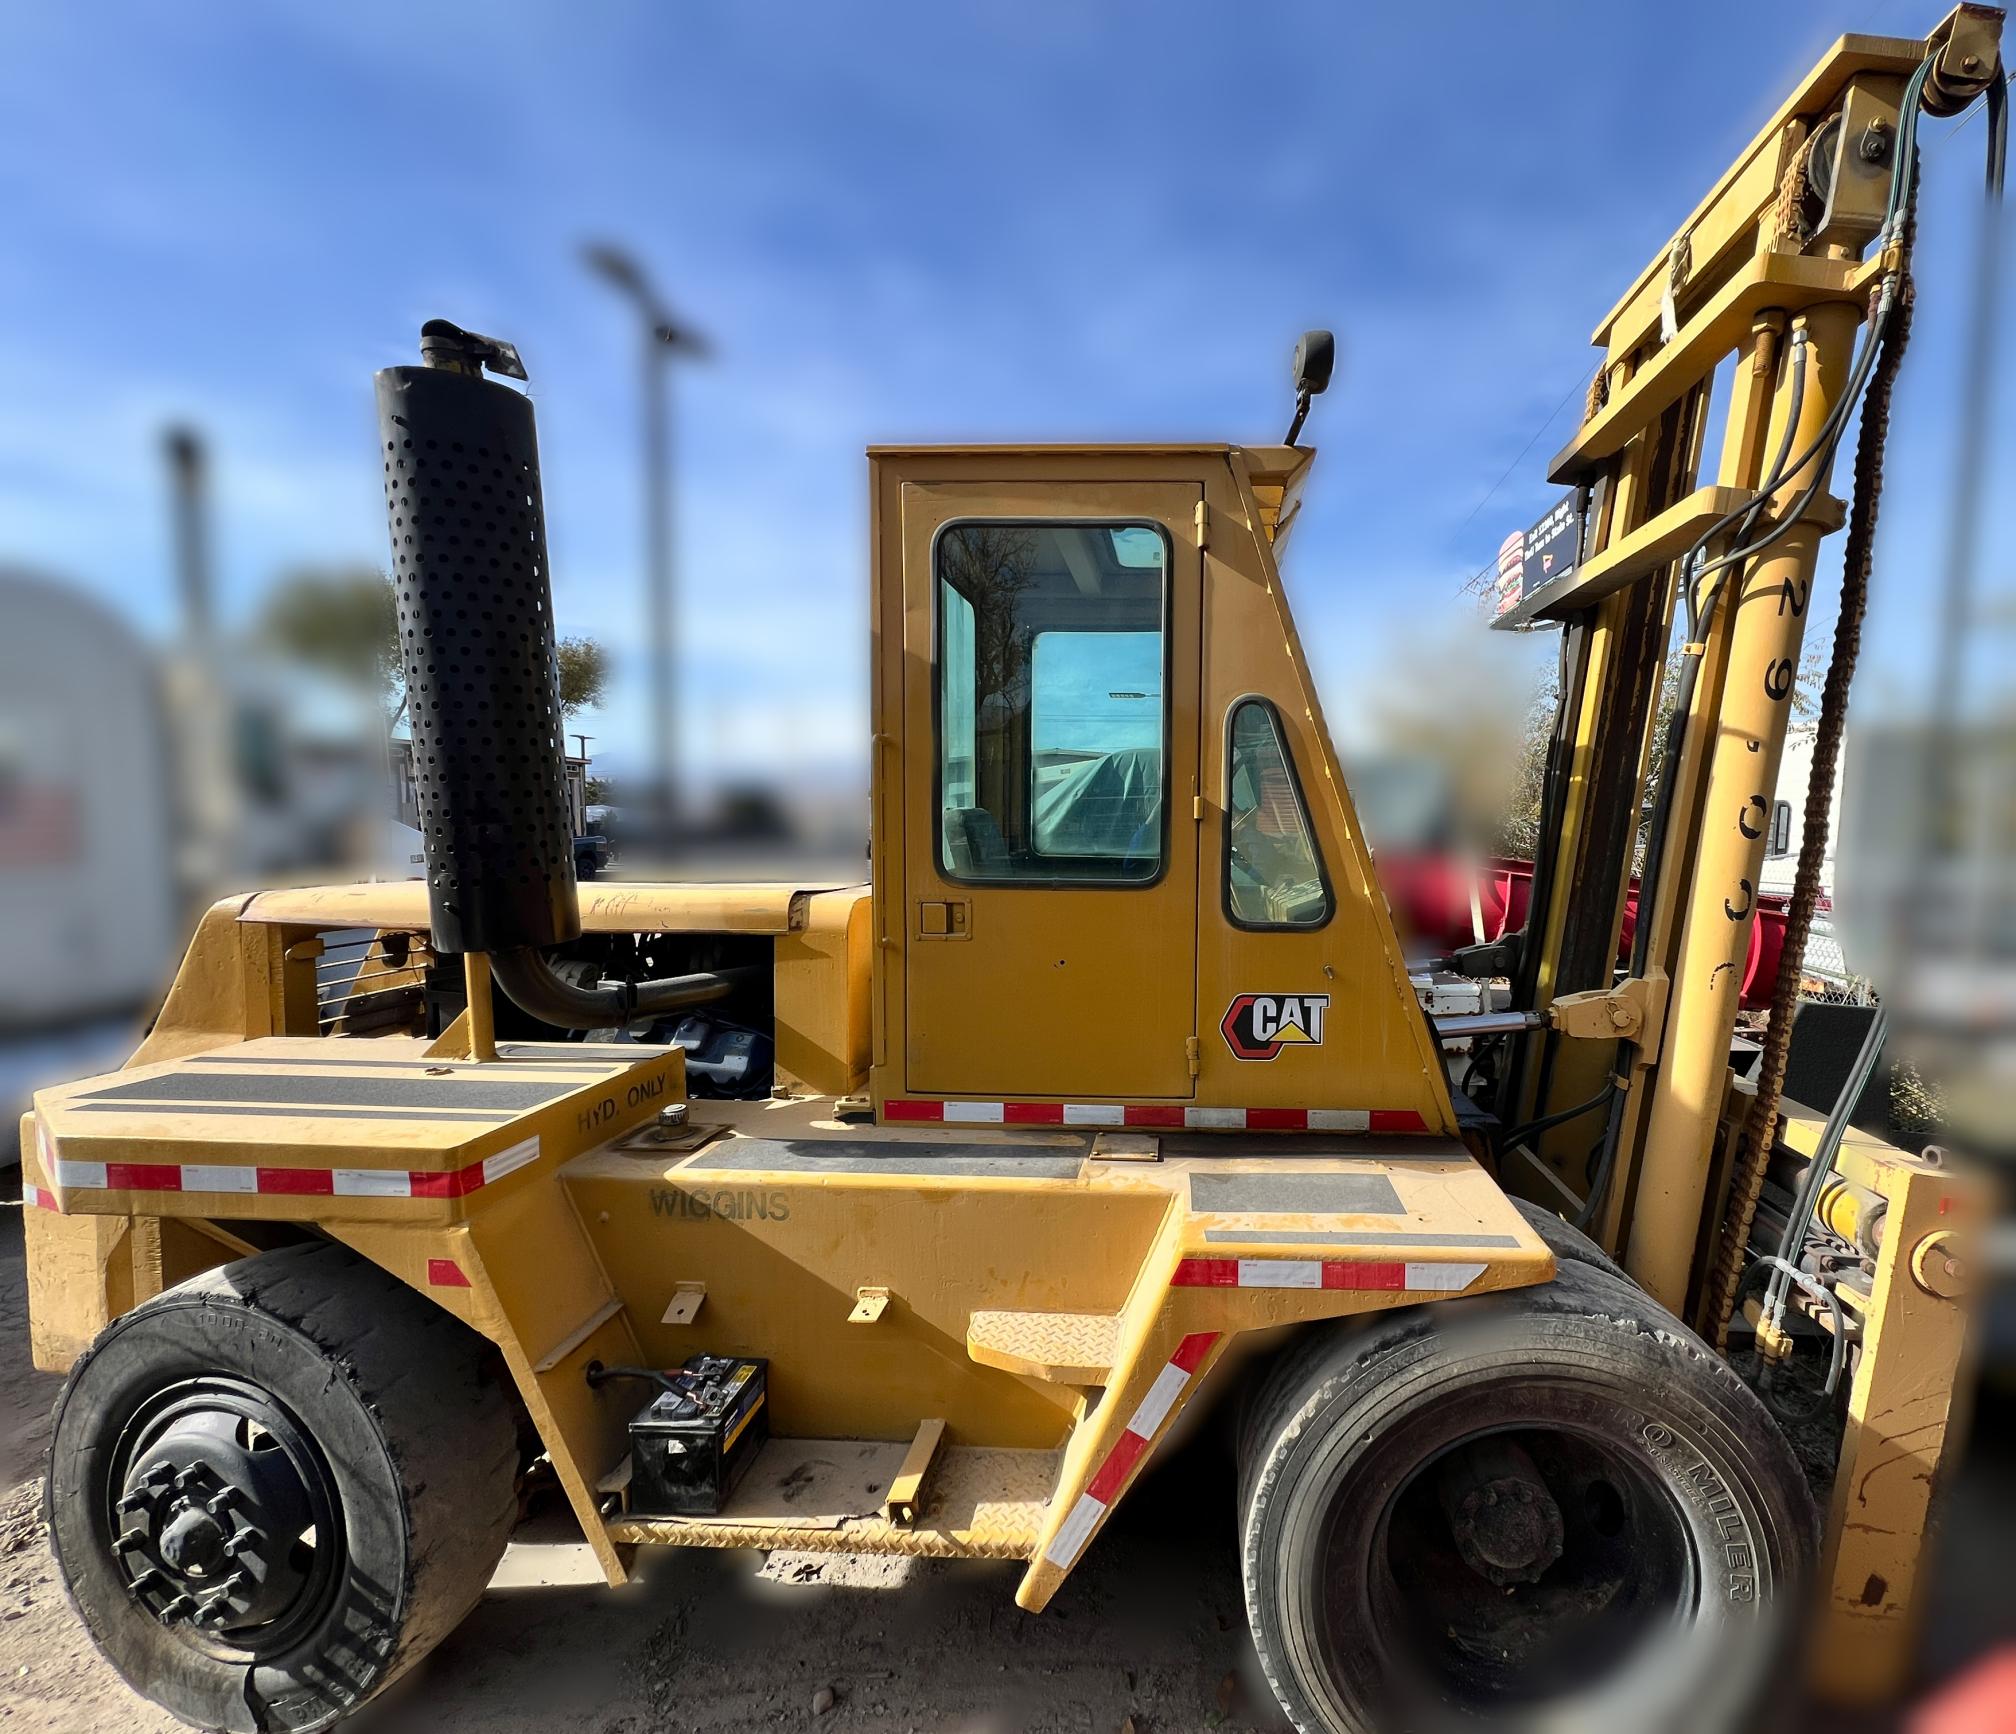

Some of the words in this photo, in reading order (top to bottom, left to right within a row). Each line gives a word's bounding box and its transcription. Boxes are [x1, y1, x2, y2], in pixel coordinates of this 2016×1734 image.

[1252, 997, 1328, 1043] CAT
[577, 1098, 620, 1134] HYD.
[627, 1072, 667, 1109] ONLY
[650, 1188, 791, 1222] WIGGINS
[1687, 1461, 1755, 1603] MILER
